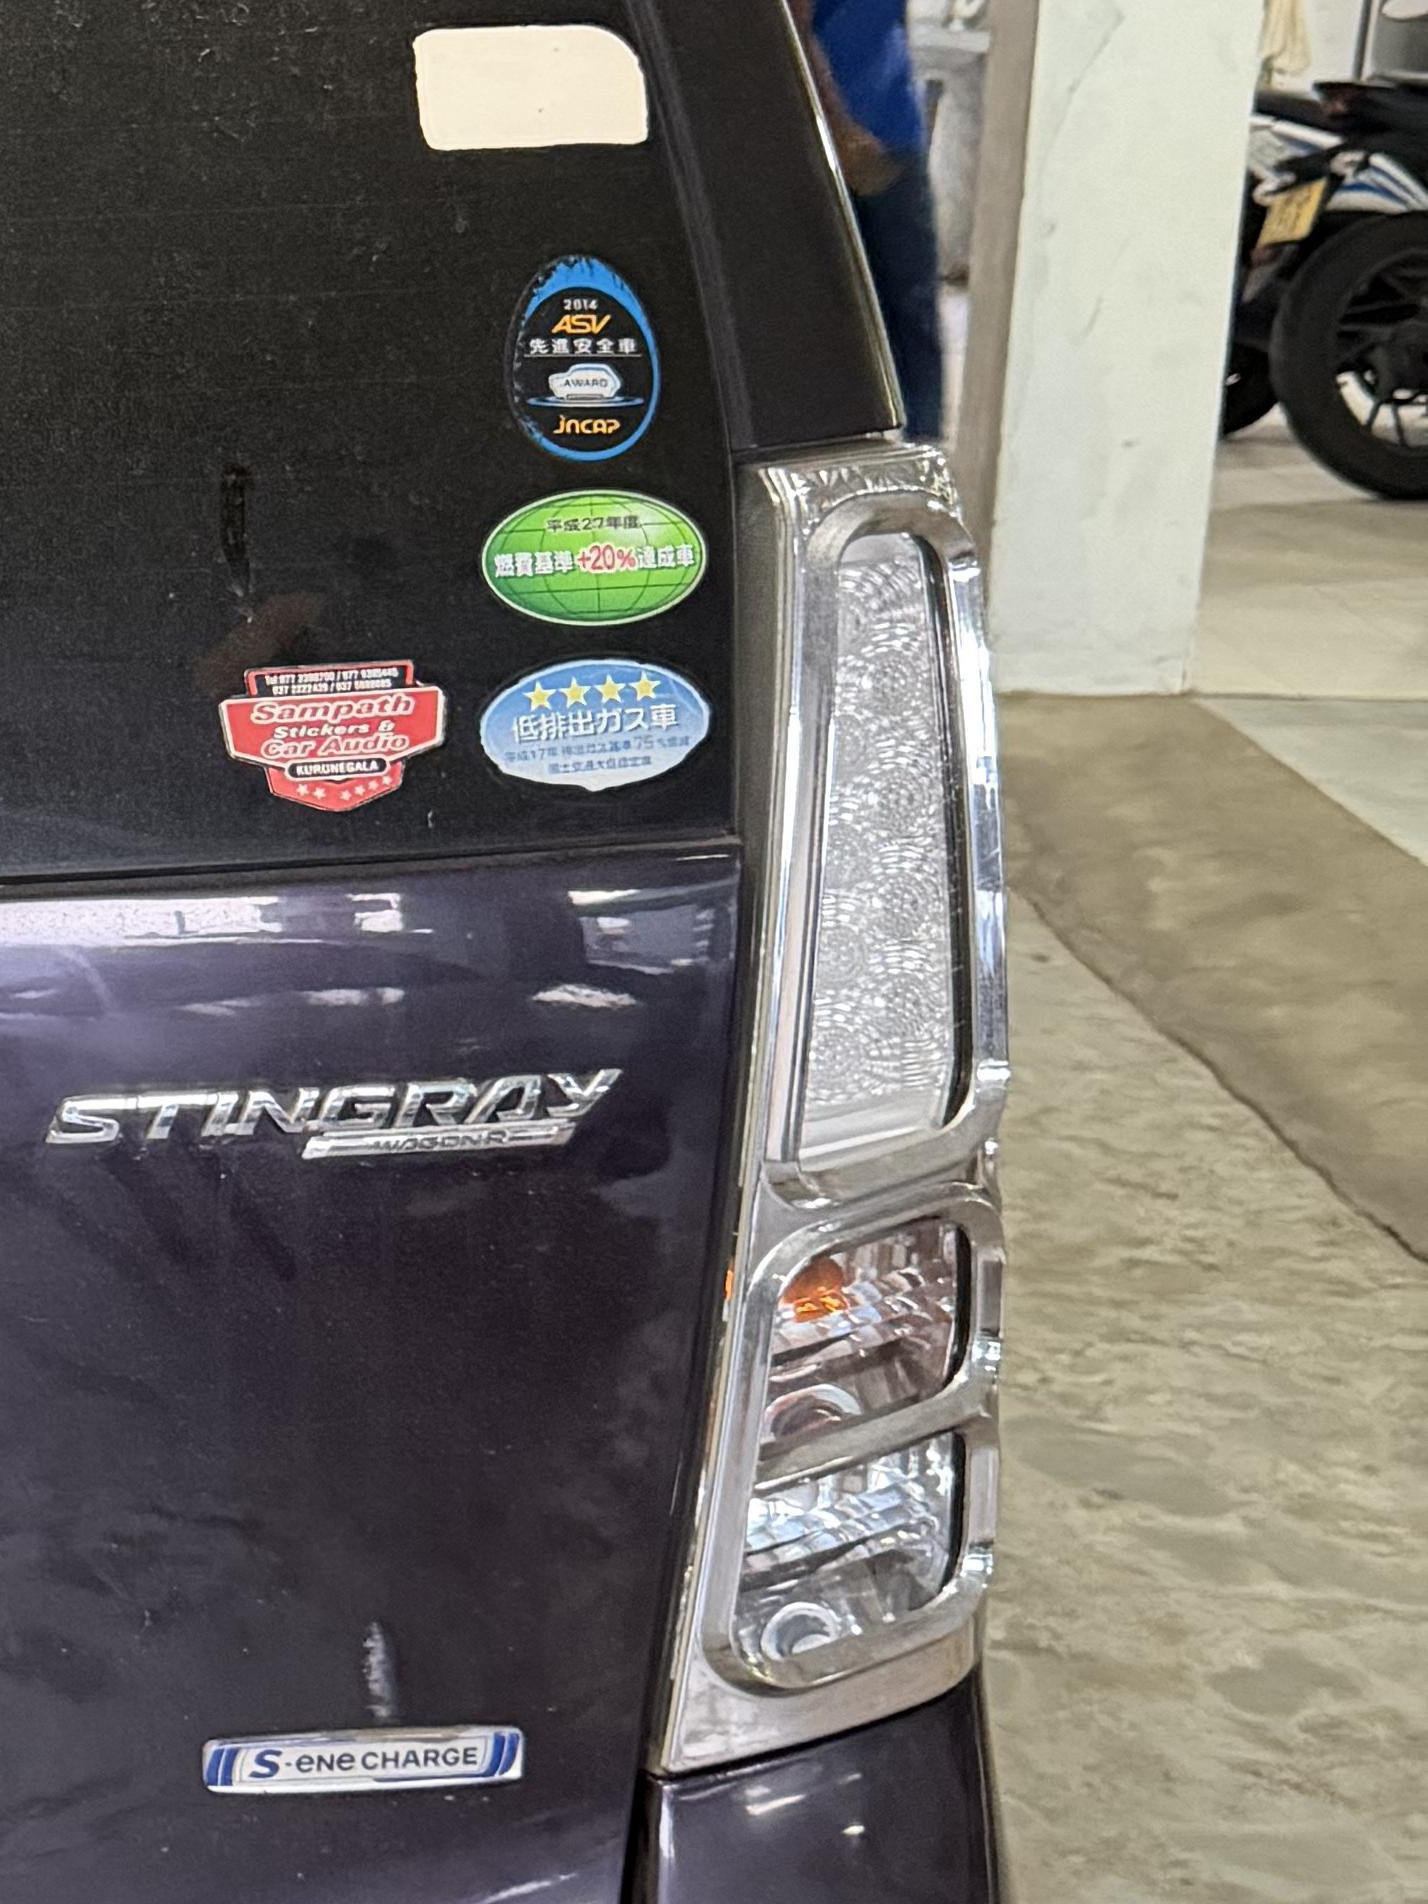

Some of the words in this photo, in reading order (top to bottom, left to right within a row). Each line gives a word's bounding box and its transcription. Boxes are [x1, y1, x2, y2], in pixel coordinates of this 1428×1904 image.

[563, 298, 598, 311] 2014
[552, 314, 612, 335] ASV
[563, 378, 609, 388] AWARD
[250, 693, 415, 724] Sampath
[273, 722, 371, 740] Stickers
[378, 720, 396, 736] &
[512, 703, 680, 744] 低排出ガス車
[260, 739, 316, 759] Car
[317, 734, 410, 756] Audio
[295, 759, 380, 776] KURUNEGALA
[45, 1067, 624, 1146] STINGRAY
[360, 1745, 479, 1772] CHARGE
